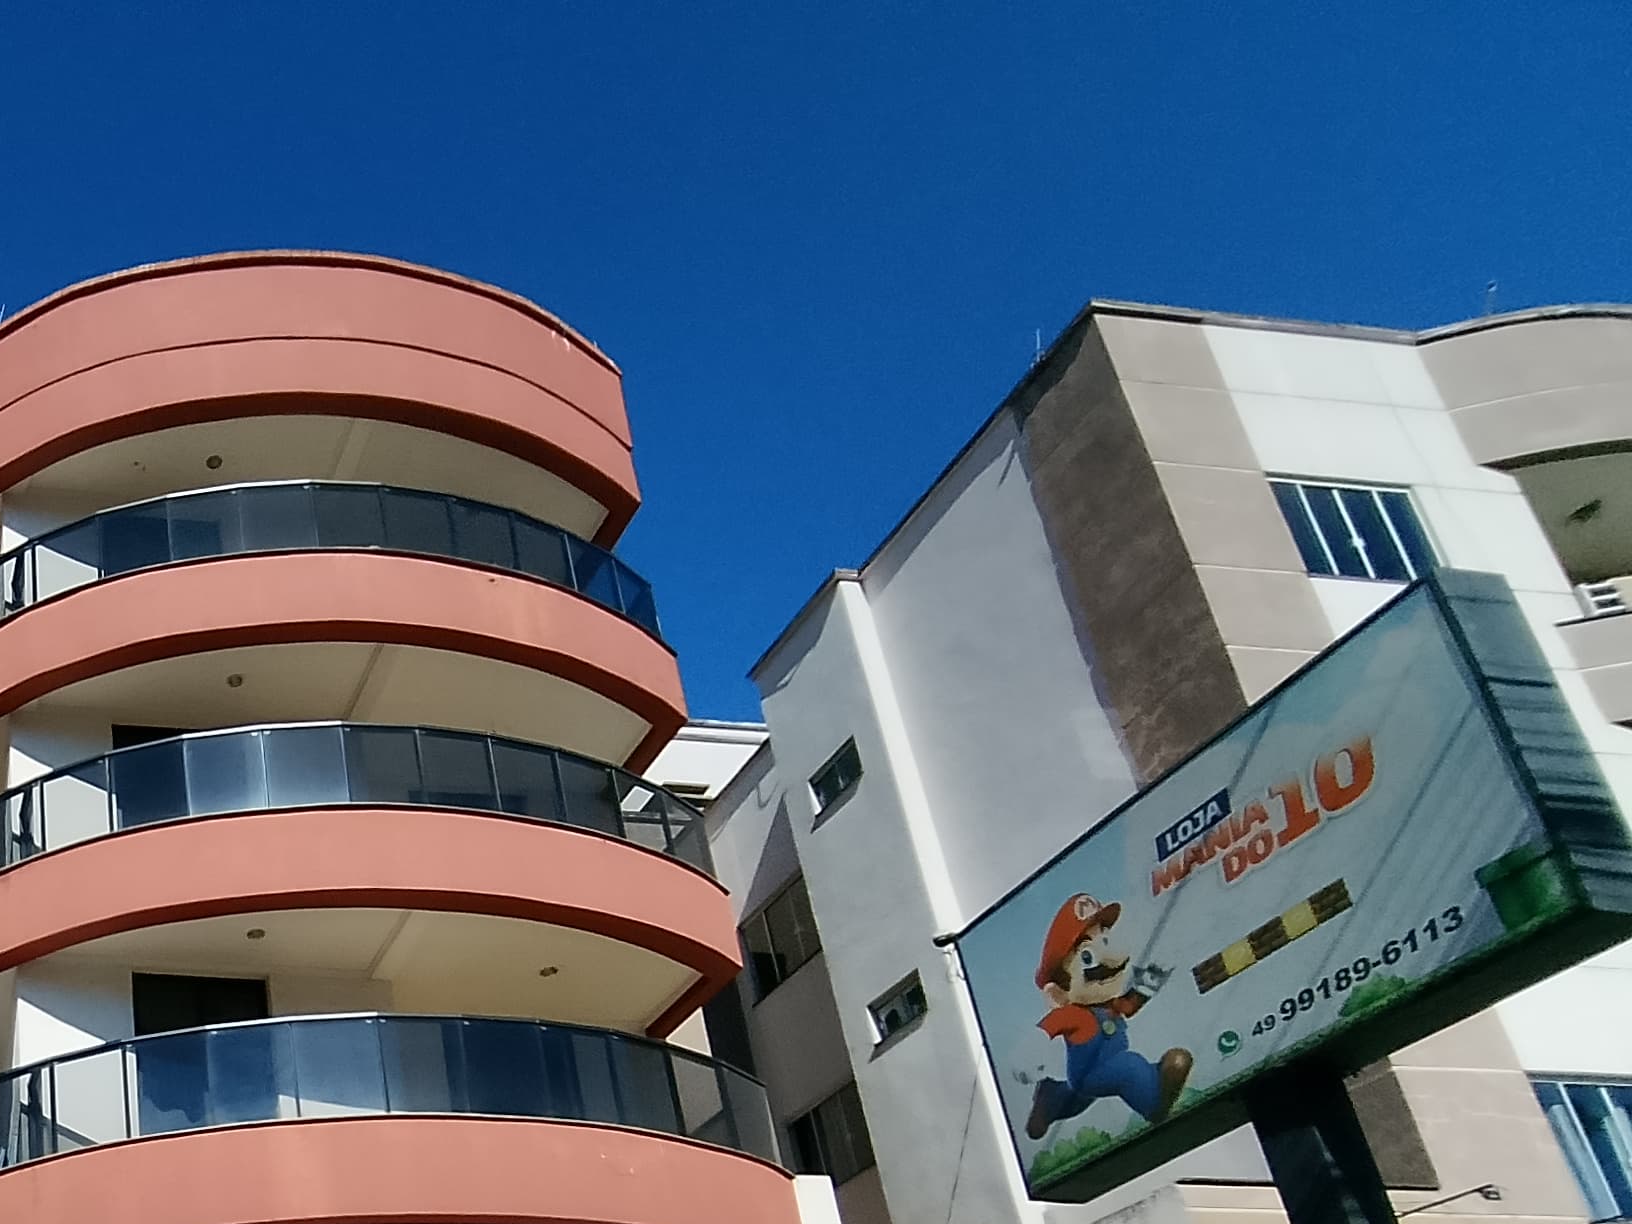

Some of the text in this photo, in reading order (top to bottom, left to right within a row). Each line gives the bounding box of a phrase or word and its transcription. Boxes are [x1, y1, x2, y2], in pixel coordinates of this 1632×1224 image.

[1165, 800, 1222, 851] LOJA
[1269, 733, 1376, 848] 10
[1151, 803, 1269, 897] MANIA
[1222, 829, 1275, 883] DO
[1251, 906, 1464, 1036] 49 99189-6113
